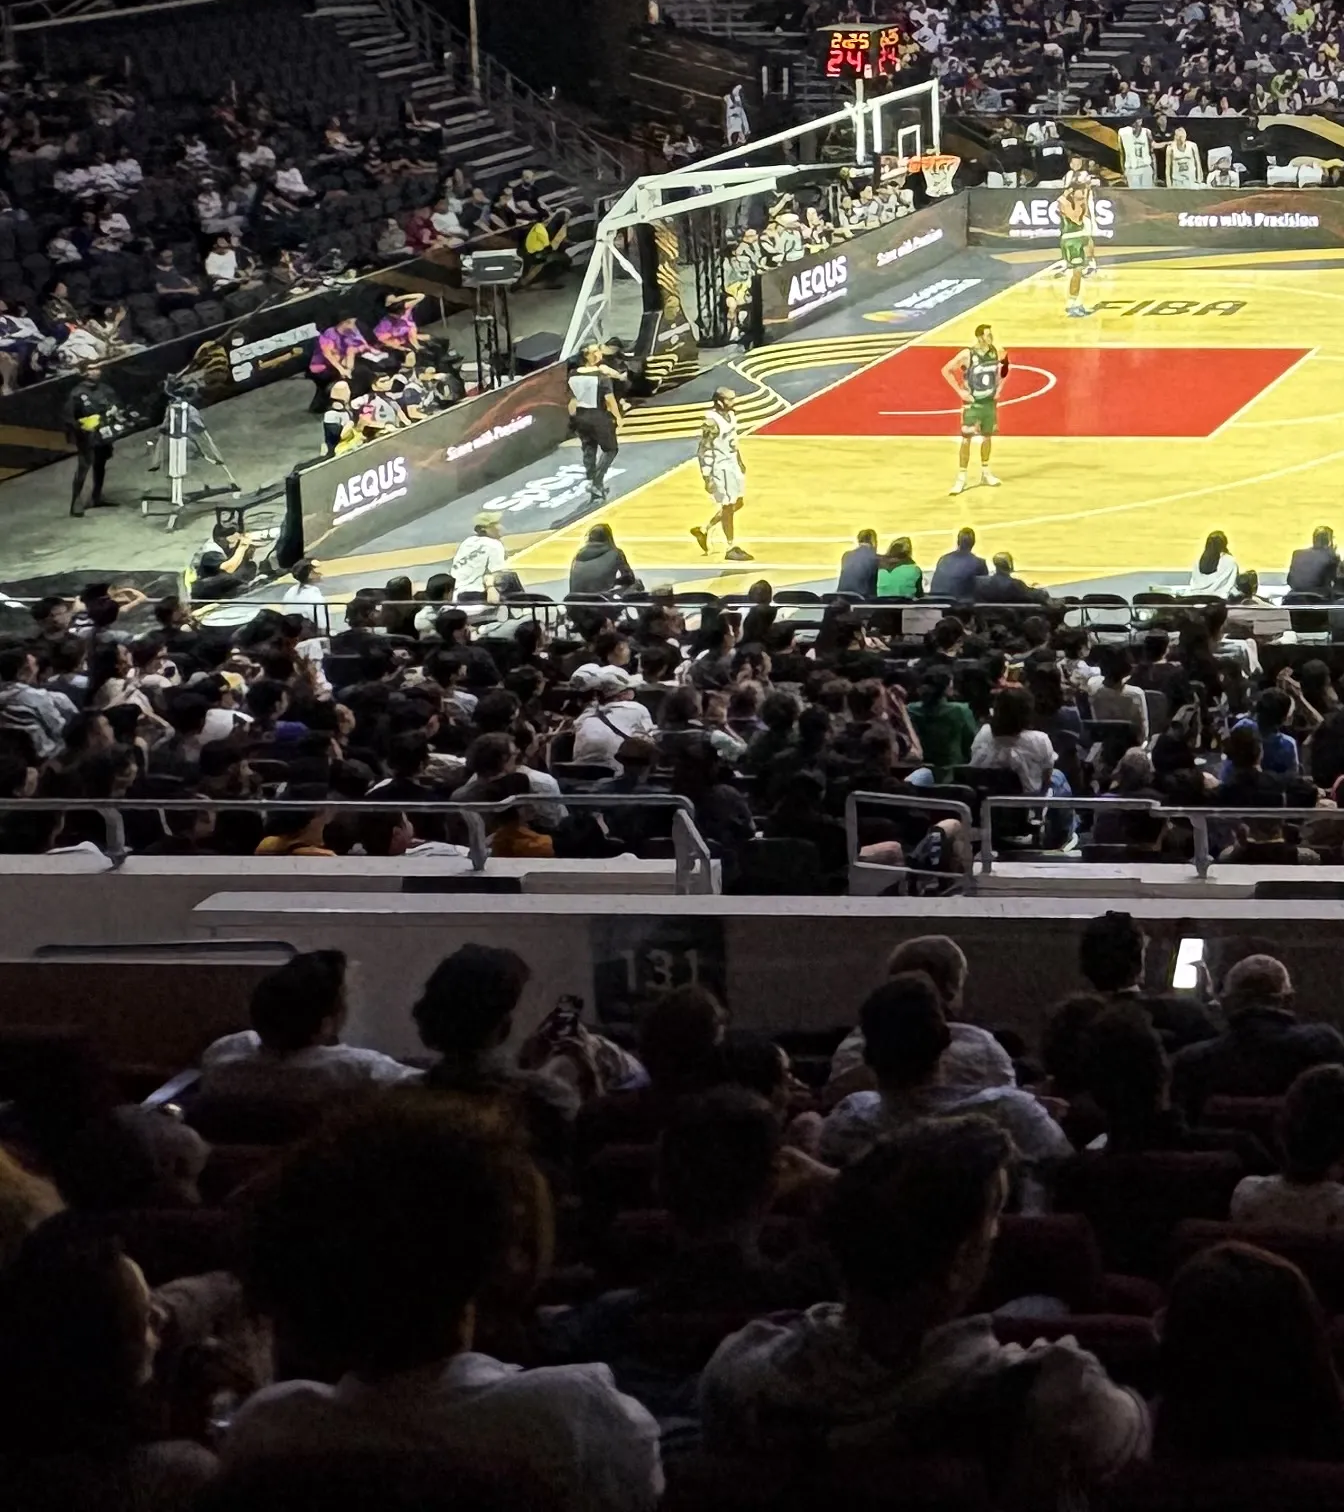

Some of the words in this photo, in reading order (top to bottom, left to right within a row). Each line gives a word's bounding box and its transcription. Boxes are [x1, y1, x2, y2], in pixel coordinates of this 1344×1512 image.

[827, 50, 862, 73] 24
[787, 255, 847, 305] AEQUS
[1091, 299, 1248, 317] FIBA
[332, 457, 407, 513] AEQUS
[619, 948, 698, 994] 131
